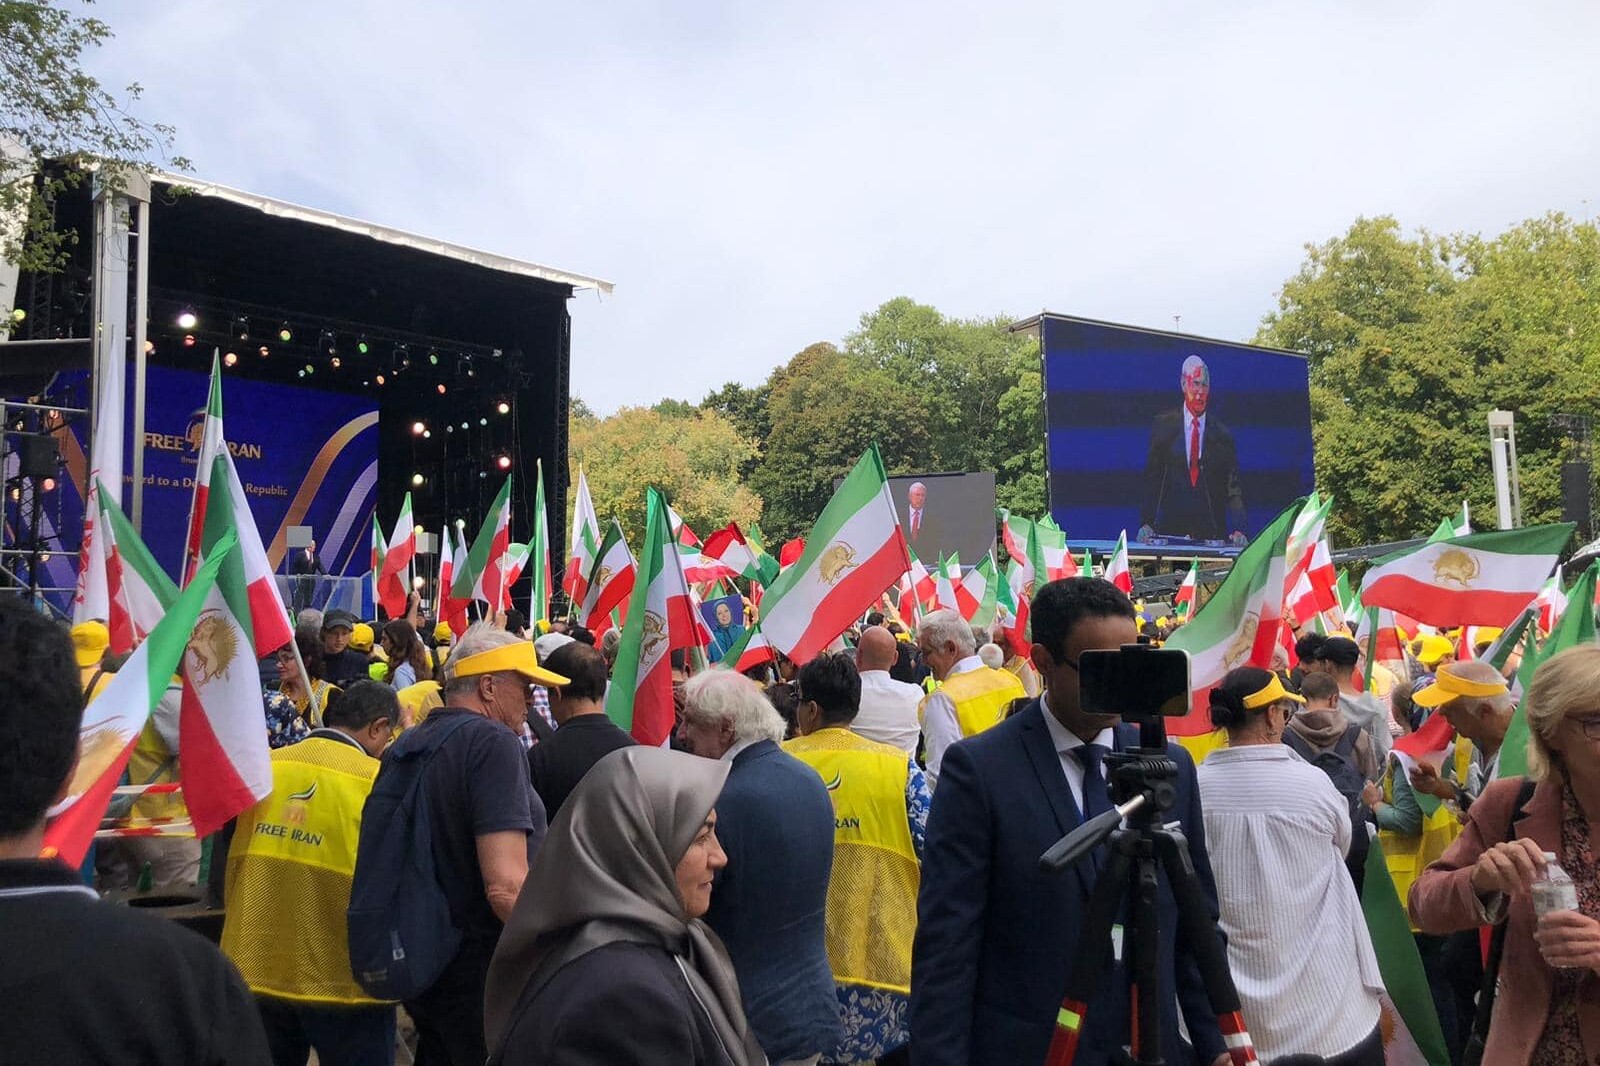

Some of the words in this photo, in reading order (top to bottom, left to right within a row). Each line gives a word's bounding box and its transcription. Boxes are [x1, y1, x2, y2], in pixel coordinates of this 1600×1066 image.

[143, 432, 185, 451] FREE
[227, 441, 261, 459] RAN
[158, 477, 169, 486] to
[245, 483, 289, 497] Republic
[834, 818, 861, 829] RAN
[255, 823, 288, 838] FREE
[291, 828, 324, 846] IRAN
